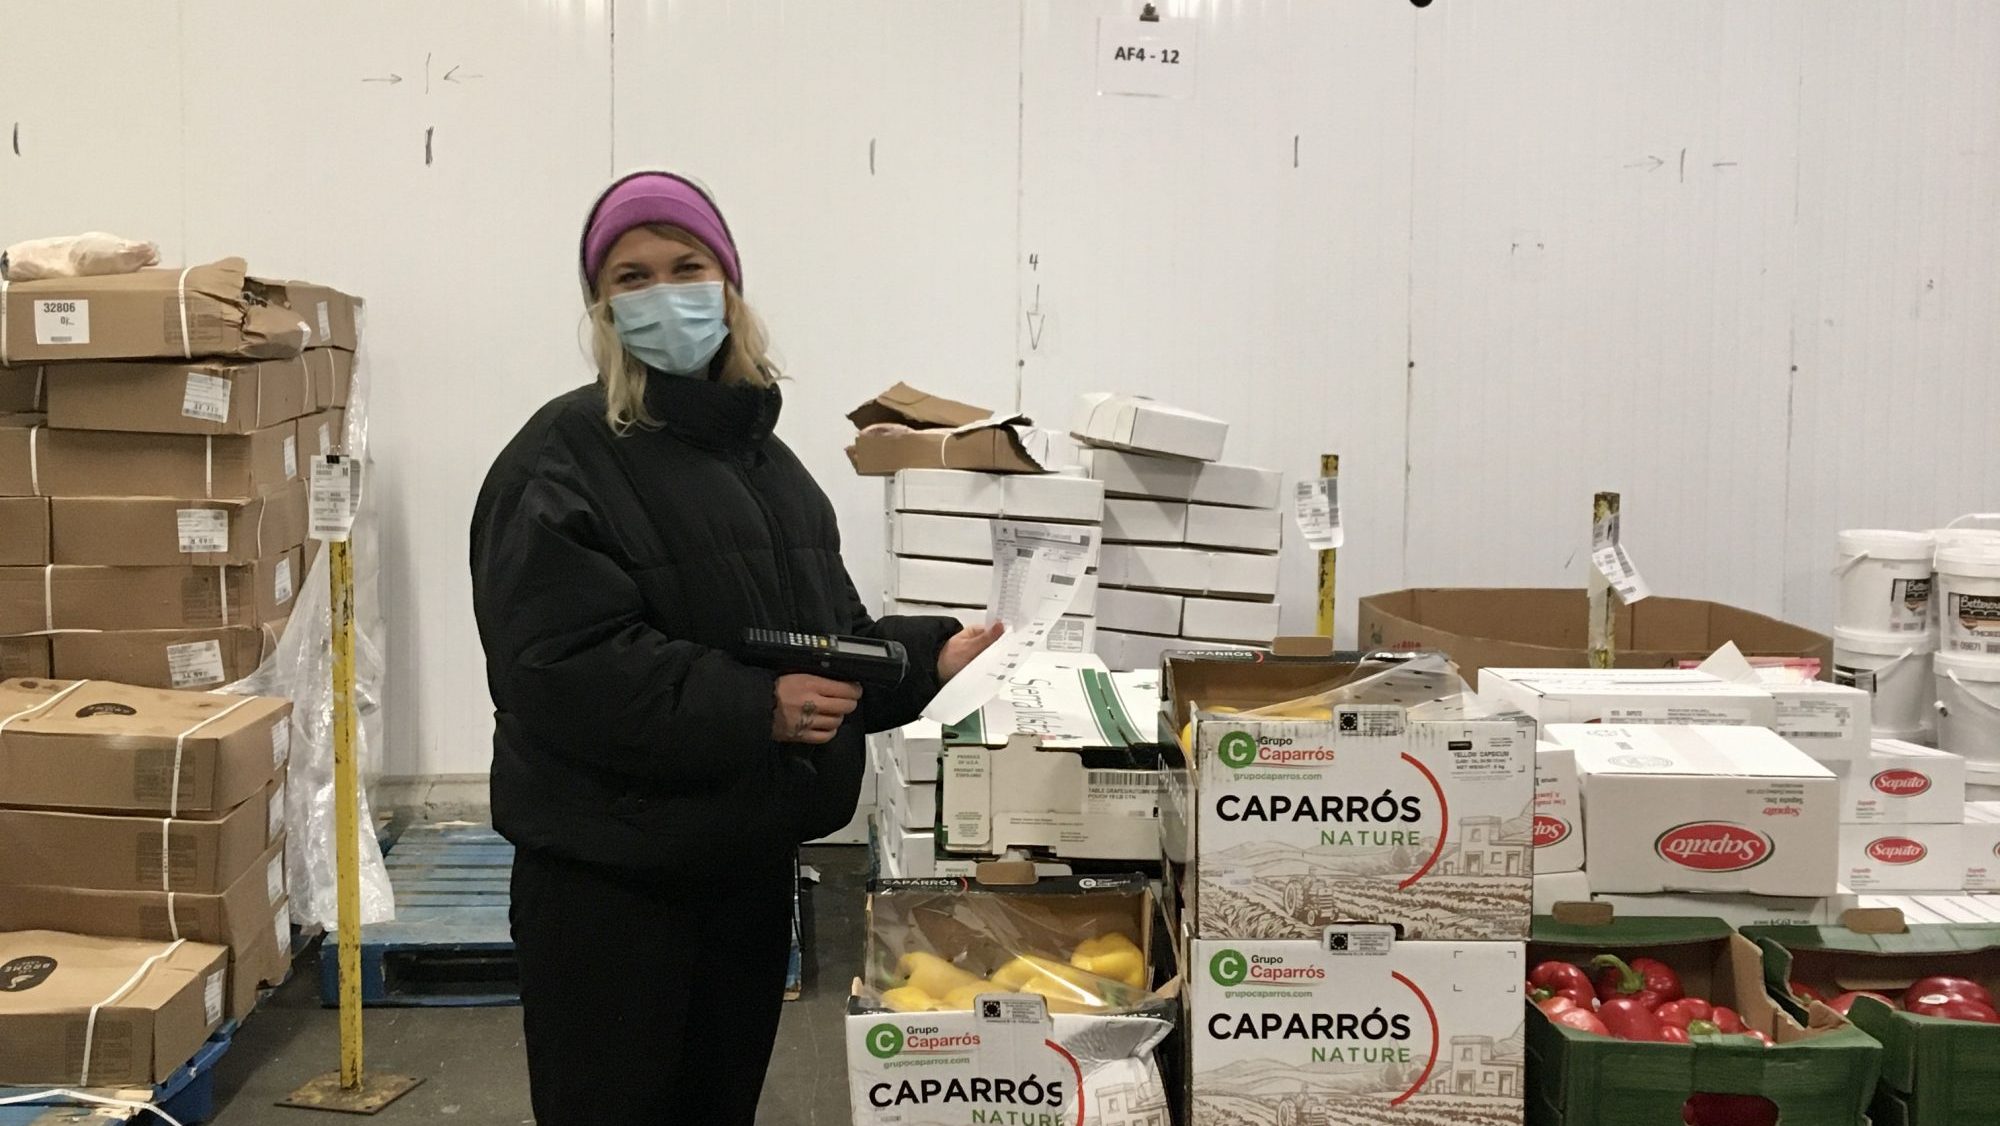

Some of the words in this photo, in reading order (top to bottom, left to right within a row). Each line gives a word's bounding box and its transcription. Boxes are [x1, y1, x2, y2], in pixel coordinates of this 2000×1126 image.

[1114, 46, 1146, 62] AF4
[1161, 49, 1180, 64] 12
[1029, 253, 1039, 272] 4
[43, 302, 76, 313] 32806
[1260, 736, 1293, 747] Grupo
[1259, 746, 1335, 763] Caparrós
[1233, 773, 1323, 781] grupocaparros.com
[1878, 774, 1926, 791] Saputo
[1216, 788, 1421, 823] CAPARRÓS
[1762, 806, 1801, 816] Saputo
[1321, 830, 1420, 846] NATURE
[1665, 832, 1760, 861] Saputo
[1872, 843, 1922, 859] Saputo
[1251, 955, 1284, 965] Grupo
[1250, 964, 1326, 980] Caparrós
[1225, 991, 1313, 999] grupocaparros.com
[906, 1026, 939, 1035] Grupo
[1208, 1006, 1411, 1041] CAPARRÓS
[907, 1032, 981, 1049] Caparrós
[1311, 1047, 1410, 1062] NATURE
[883, 1057, 970, 1069] grupocaparros.com
[868, 1073, 1063, 1108] CAPARRÓS
[972, 1109, 1064, 1126] NATURE
